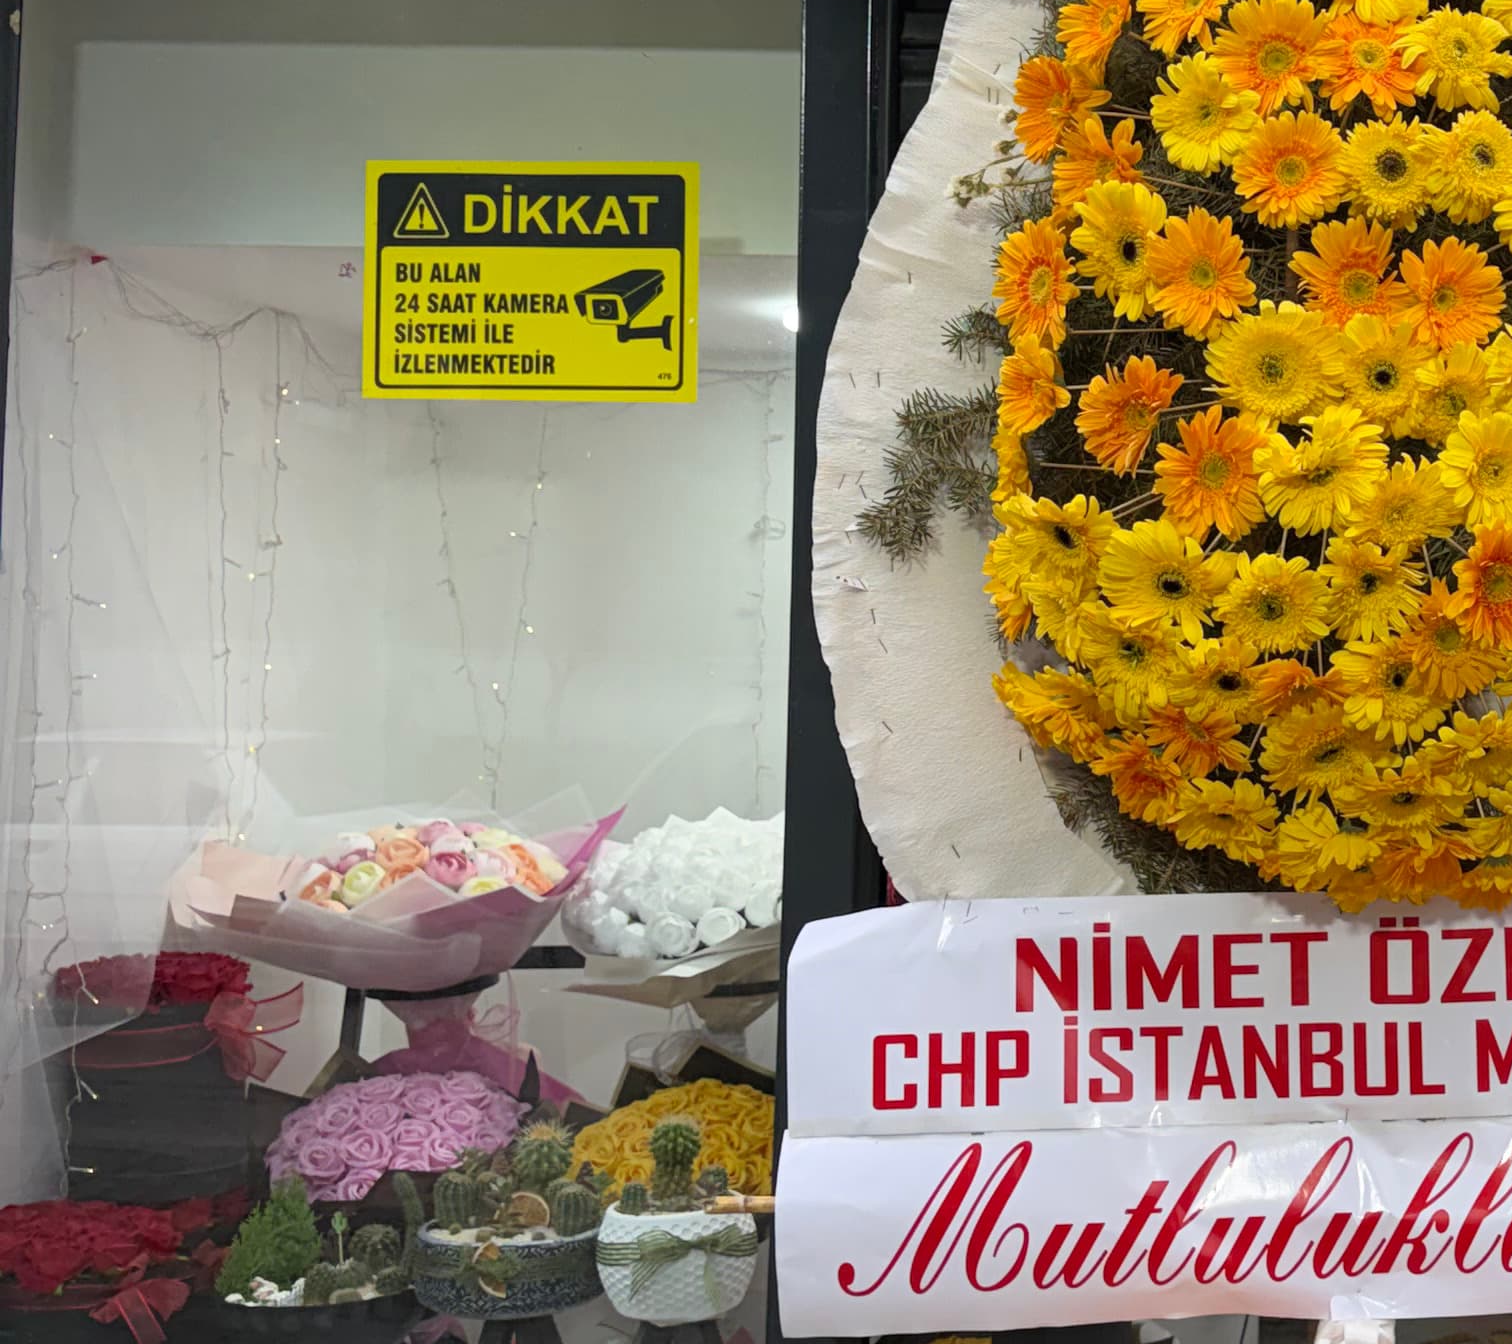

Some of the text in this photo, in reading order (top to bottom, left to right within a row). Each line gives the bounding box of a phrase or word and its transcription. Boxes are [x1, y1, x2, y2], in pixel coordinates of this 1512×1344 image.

[464, 184, 660, 235] DİKKAT
[395, 263, 481, 284] BU ALAN
[395, 293, 569, 315] 24 SAAT KAMERA
[395, 318, 514, 345] SİSTEMİ İLE
[394, 349, 555, 375] İZLENMEKTEDİR
[1015, 922, 1329, 1013] NİMET
[872, 1030, 1031, 1111] CHP
[1063, 1015, 1447, 1105] İSTANBUL
